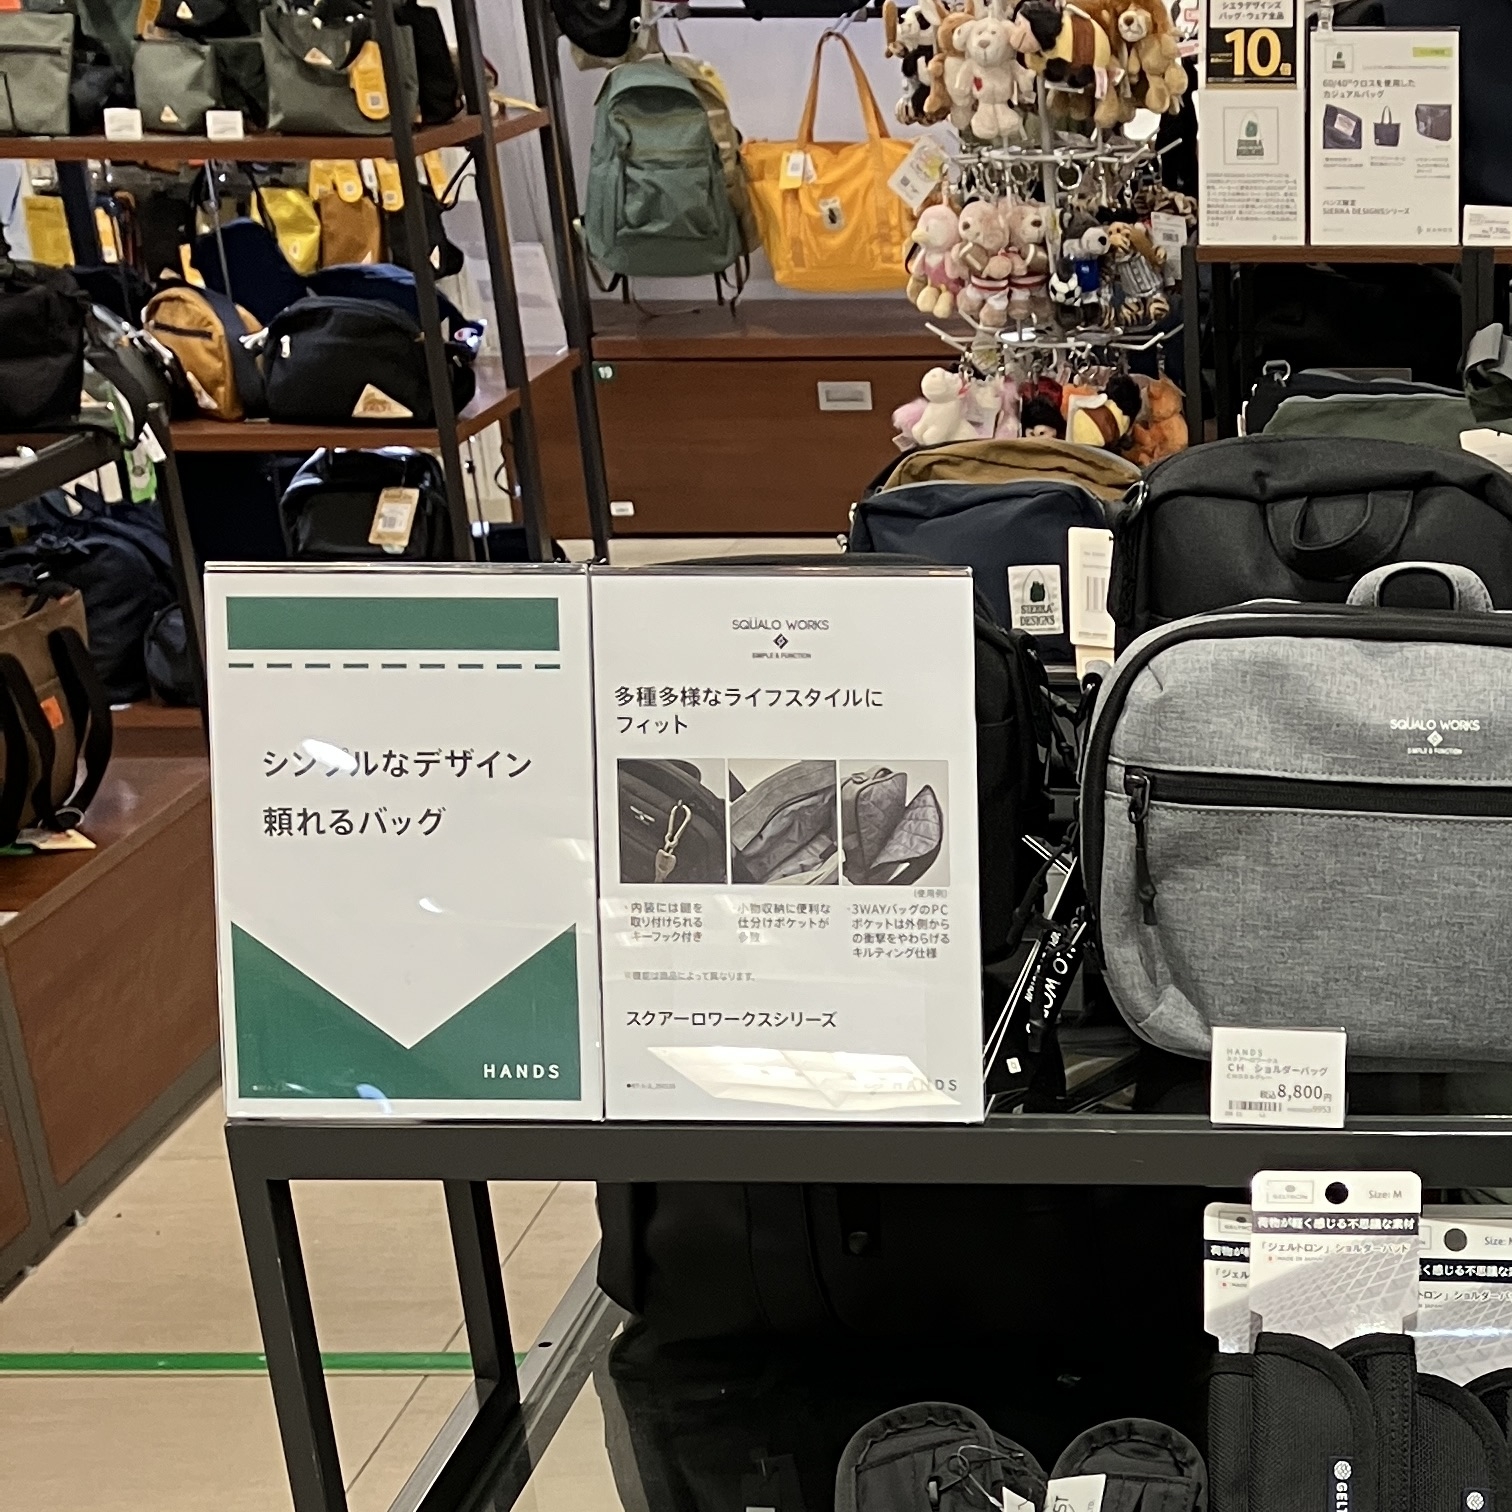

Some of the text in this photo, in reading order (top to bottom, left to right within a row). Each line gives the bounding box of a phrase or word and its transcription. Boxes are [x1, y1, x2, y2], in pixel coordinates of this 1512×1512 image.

[785, 619, 830, 630] WORKS
[1020, 615, 1055, 626] DESIGNS
[614, 686, 884, 709] 多種多様なライフスタイルに
[616, 714, 688, 735] フィット
[1440, 719, 1481, 731] WORKS
[263, 805, 446, 837] 頼れるバッグ
[631, 916, 703, 928] 取り付けられる
[738, 917, 830, 929] 仕分けポケットが
[632, 931, 702, 943] キーフック付き
[626, 1011, 837, 1028] スクアーロワークスシリーズ
[1227, 1048, 1263, 1058] HANDS
[483, 1063, 560, 1080] HANDS
[1228, 1063, 1245, 1072] CH
[1254, 1065, 1328, 1077] ショルダーバッグ
[1368, 1190, 1403, 1199] Size: M
